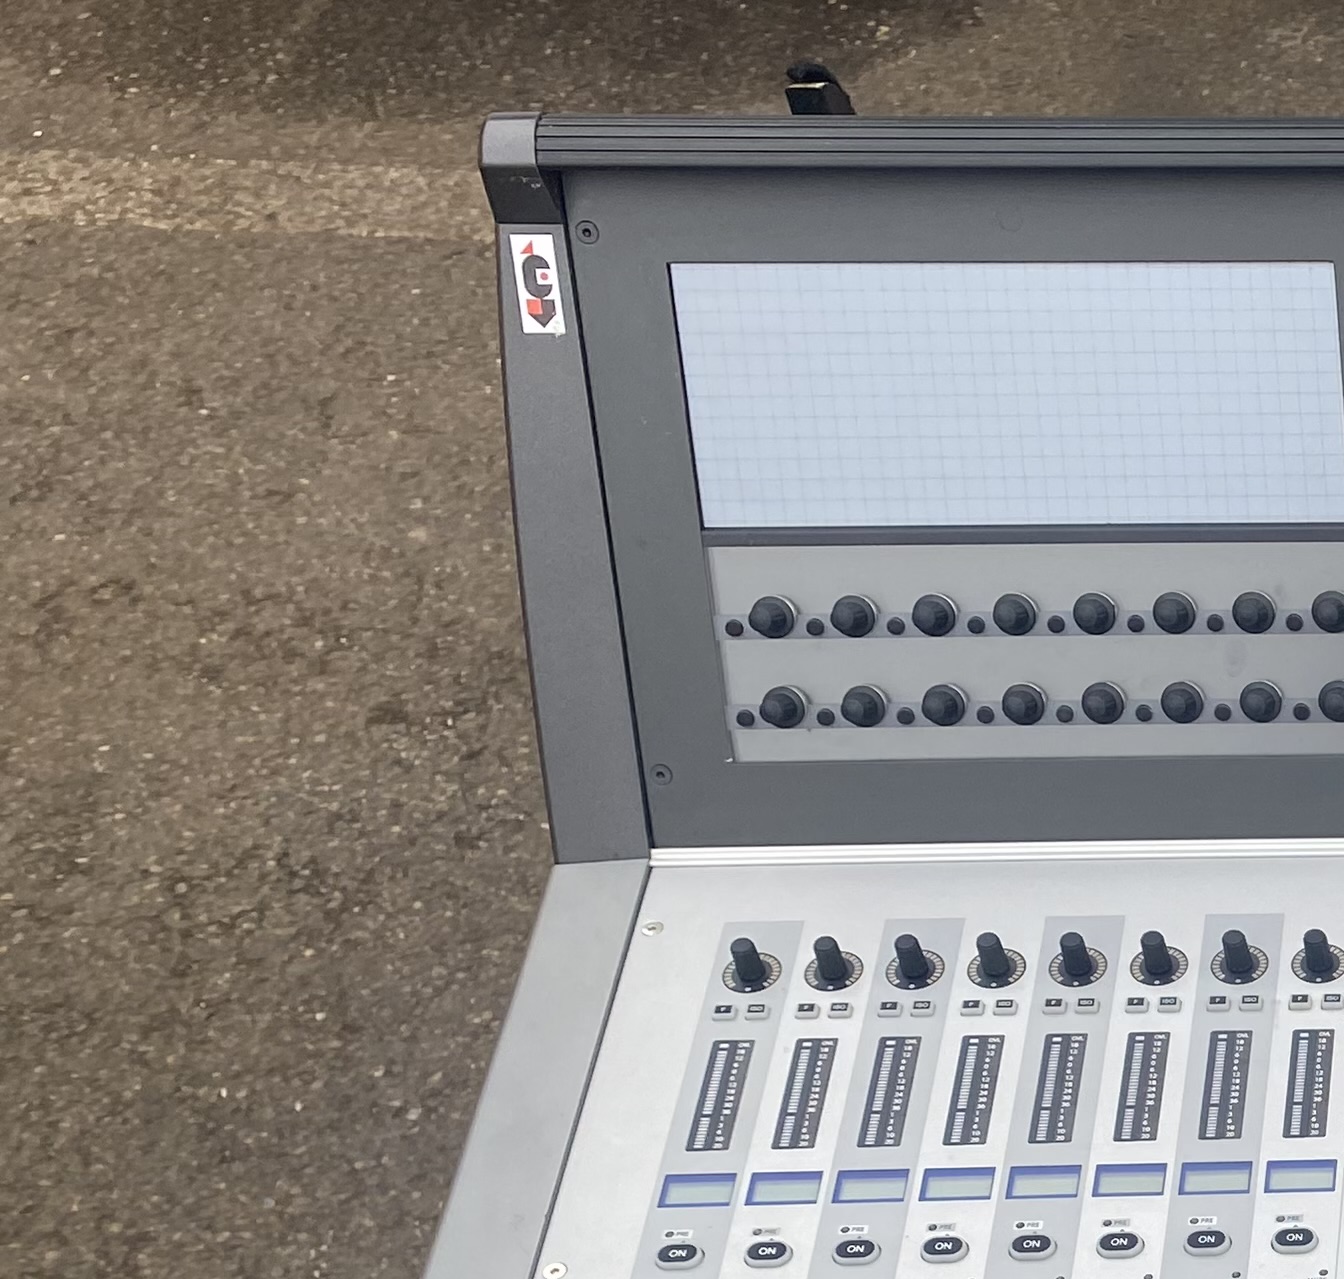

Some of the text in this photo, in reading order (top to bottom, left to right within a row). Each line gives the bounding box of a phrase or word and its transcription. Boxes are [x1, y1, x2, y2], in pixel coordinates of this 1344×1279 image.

[1022, 1240, 1041, 1248] ON
[1110, 1237, 1128, 1246] ON
[1198, 1235, 1215, 1244] ON
[668, 1248, 687, 1257] ON
[758, 1246, 776, 1255] ON
[847, 1244, 865, 1253] ON
